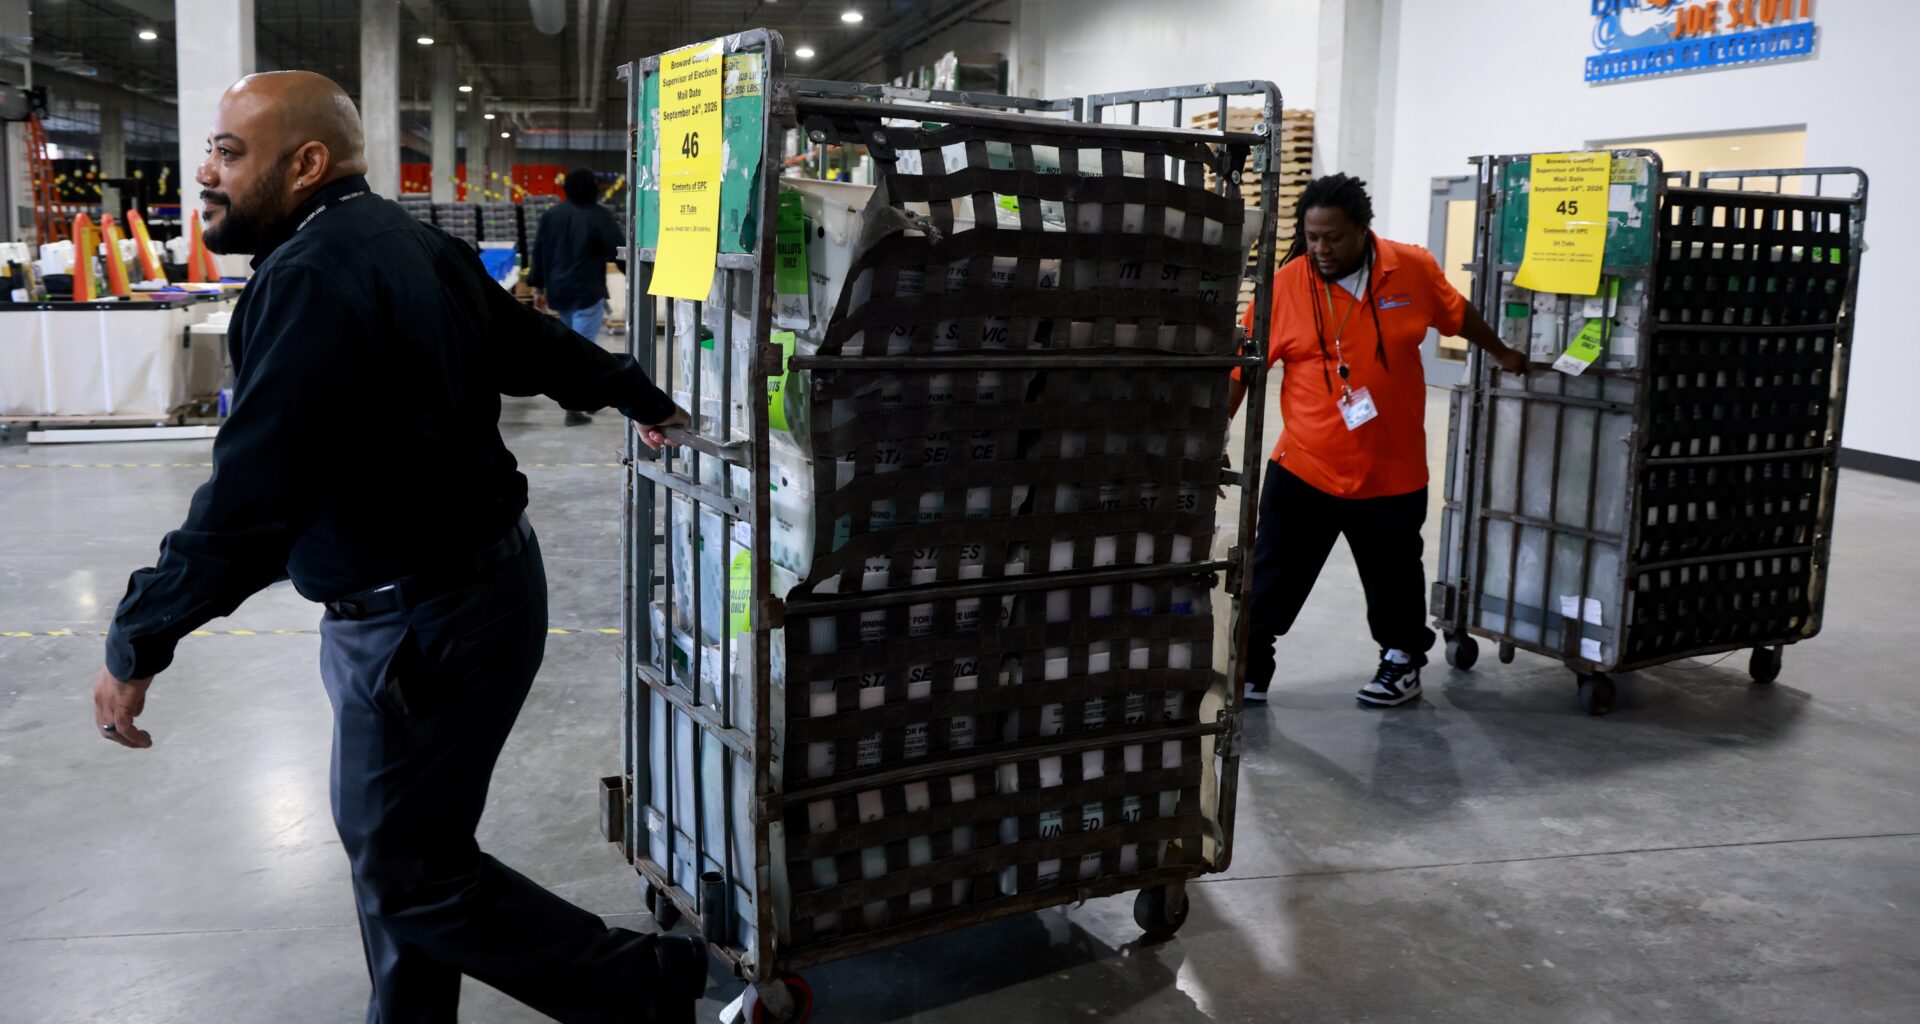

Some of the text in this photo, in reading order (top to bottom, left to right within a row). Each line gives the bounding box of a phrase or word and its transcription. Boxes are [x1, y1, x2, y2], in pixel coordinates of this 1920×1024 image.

[1670, 4, 1718, 37] JOE
[671, 56, 691, 70] Broward
[663, 68, 718, 87] Supervisor of Elections
[678, 88, 701, 100] Mail Date
[663, 108, 691, 122] September
[704, 101, 718, 114] 2026
[682, 132, 699, 158] 46
[692, 182, 696, 190] of
[1556, 200, 1578, 215] 45
[778, 243, 801, 254] BALLOTS
[783, 257, 796, 268] ONLY
[730, 602, 746, 613] ONLY
[913, 616, 930, 624] FOR
